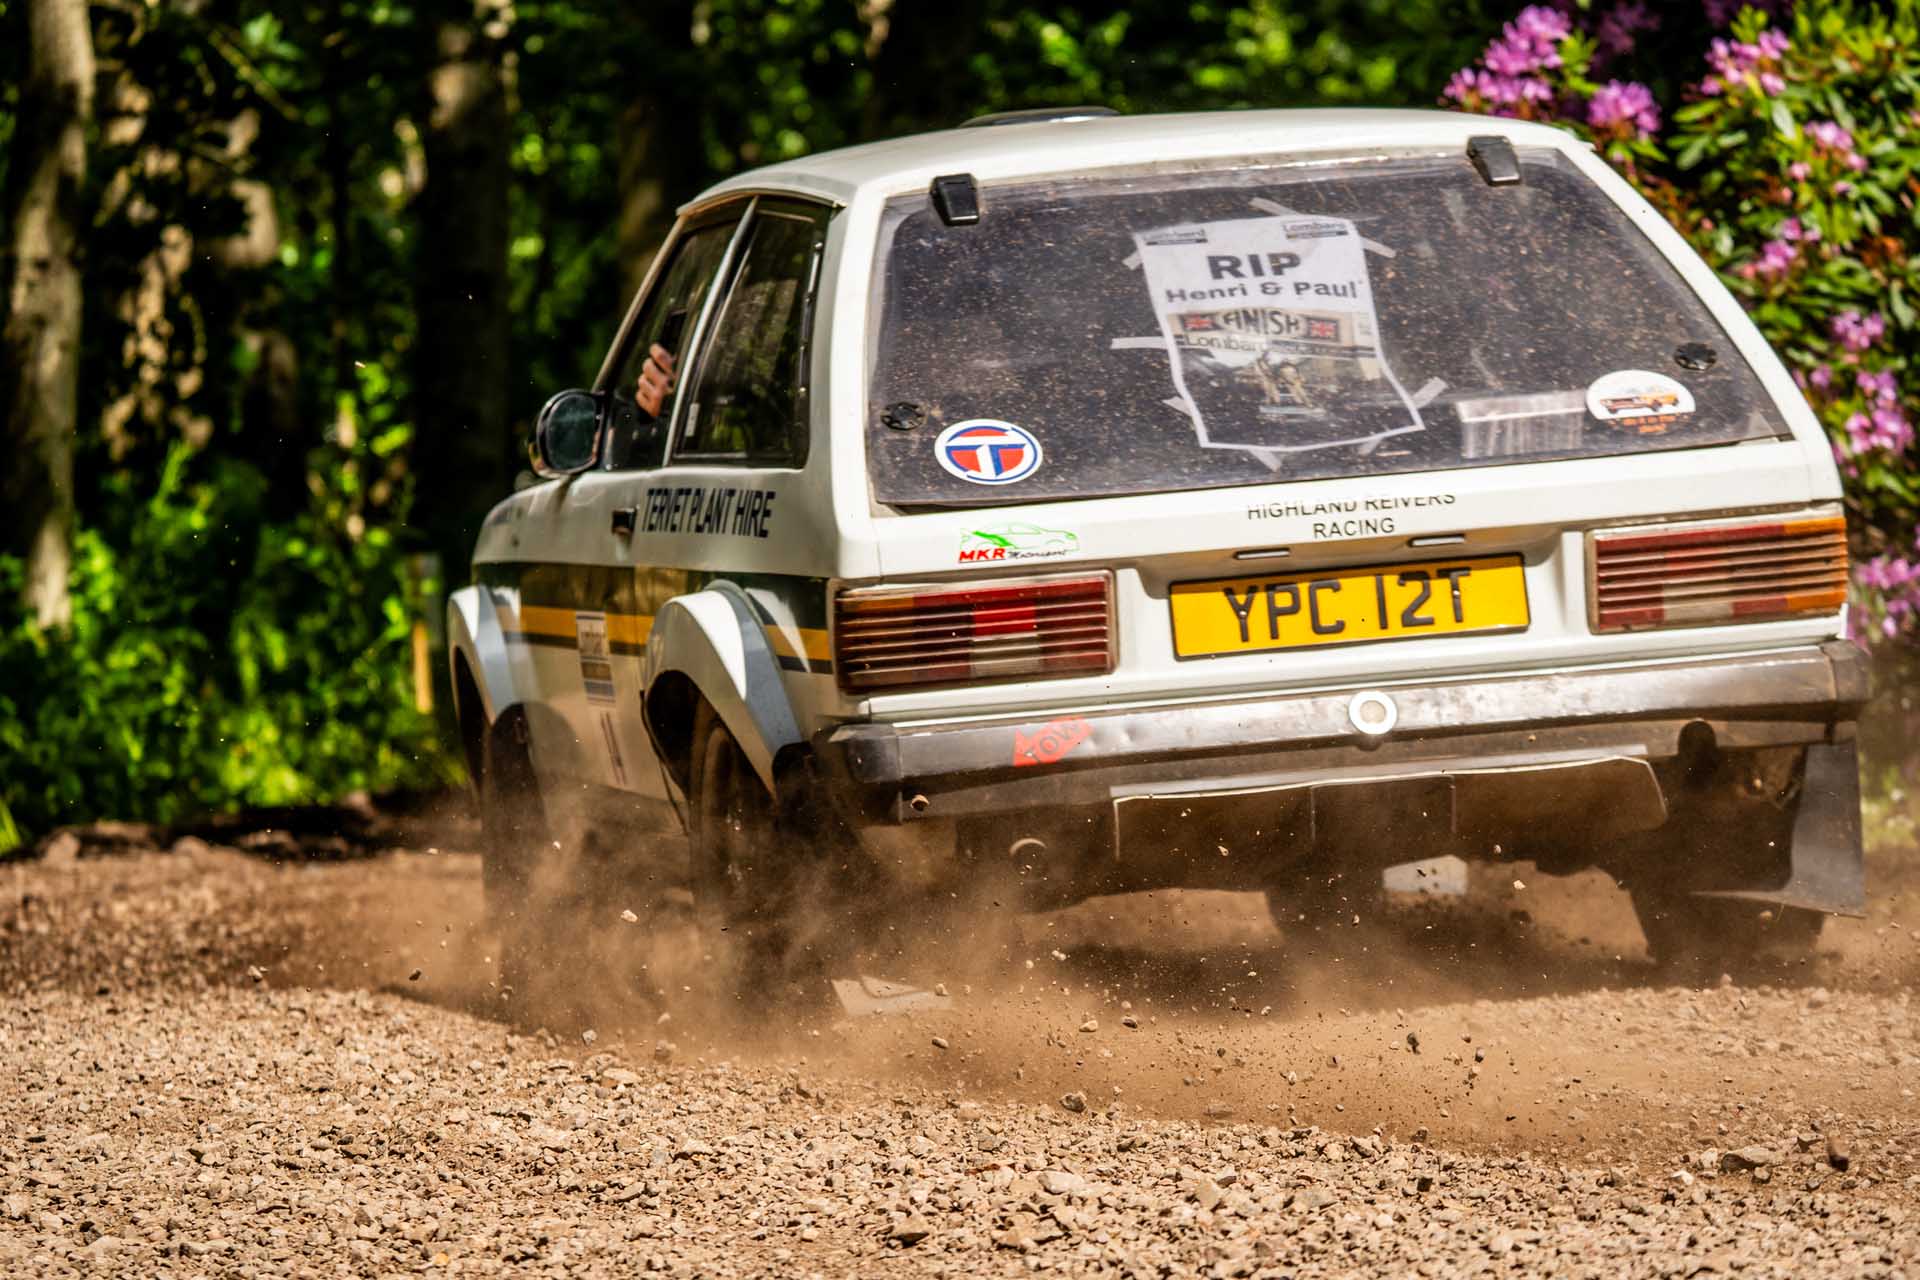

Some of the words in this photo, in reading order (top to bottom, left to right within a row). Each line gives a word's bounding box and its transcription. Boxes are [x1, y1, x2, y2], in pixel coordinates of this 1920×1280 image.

[1207, 252, 1302, 280] RIP
[1165, 283, 1248, 303] Henri
[1260, 281, 1281, 295] &
[1294, 281, 1357, 299] Paul
[1222, 309, 1300, 336] FINISH
[641, 488, 692, 532] TERVET
[686, 488, 736, 534] PLANT
[732, 489, 776, 538] HIRE
[1247, 502, 1357, 520] HIGHLAND
[1312, 517, 1395, 539] RACING
[959, 548, 1005, 561] MKR
[1223, 579, 1346, 643] YPC
[1374, 566, 1472, 631] 12T
